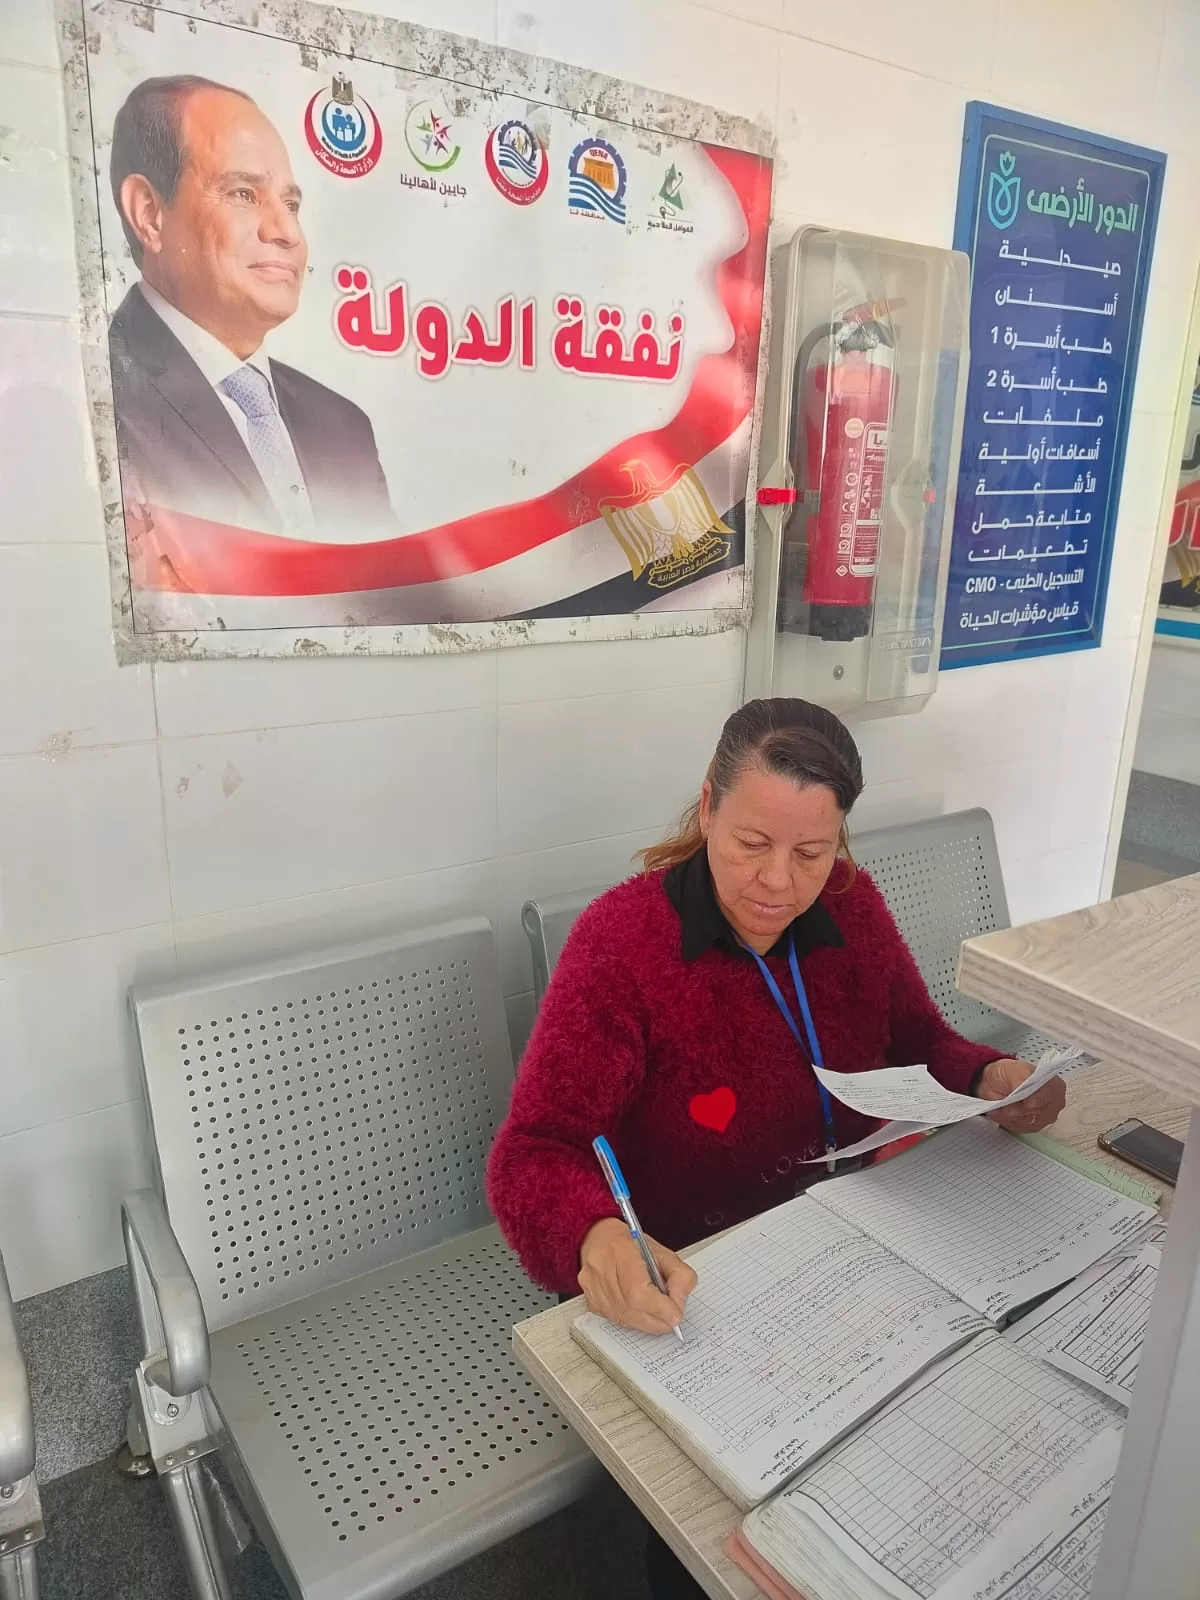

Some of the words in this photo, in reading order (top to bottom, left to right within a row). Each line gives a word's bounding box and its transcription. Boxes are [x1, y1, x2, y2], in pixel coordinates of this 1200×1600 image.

[589, 149, 609, 161] QENA
[399, 172, 437, 191] لأهالينا
[1095, 202, 1138, 236] الدور
[335, 265, 536, 379] الدولة
[551, 294, 683, 384] نفقة
[990, 326, 999, 344] 1
[986, 369, 998, 389] 2
[965, 576, 997, 593] CMO
[1042, 568, 1085, 592] التسجيل
[960, 611, 999, 631] الحياة
[1000, 603, 1047, 627] مؤشرات
[1047, 601, 1080, 623] قياس
